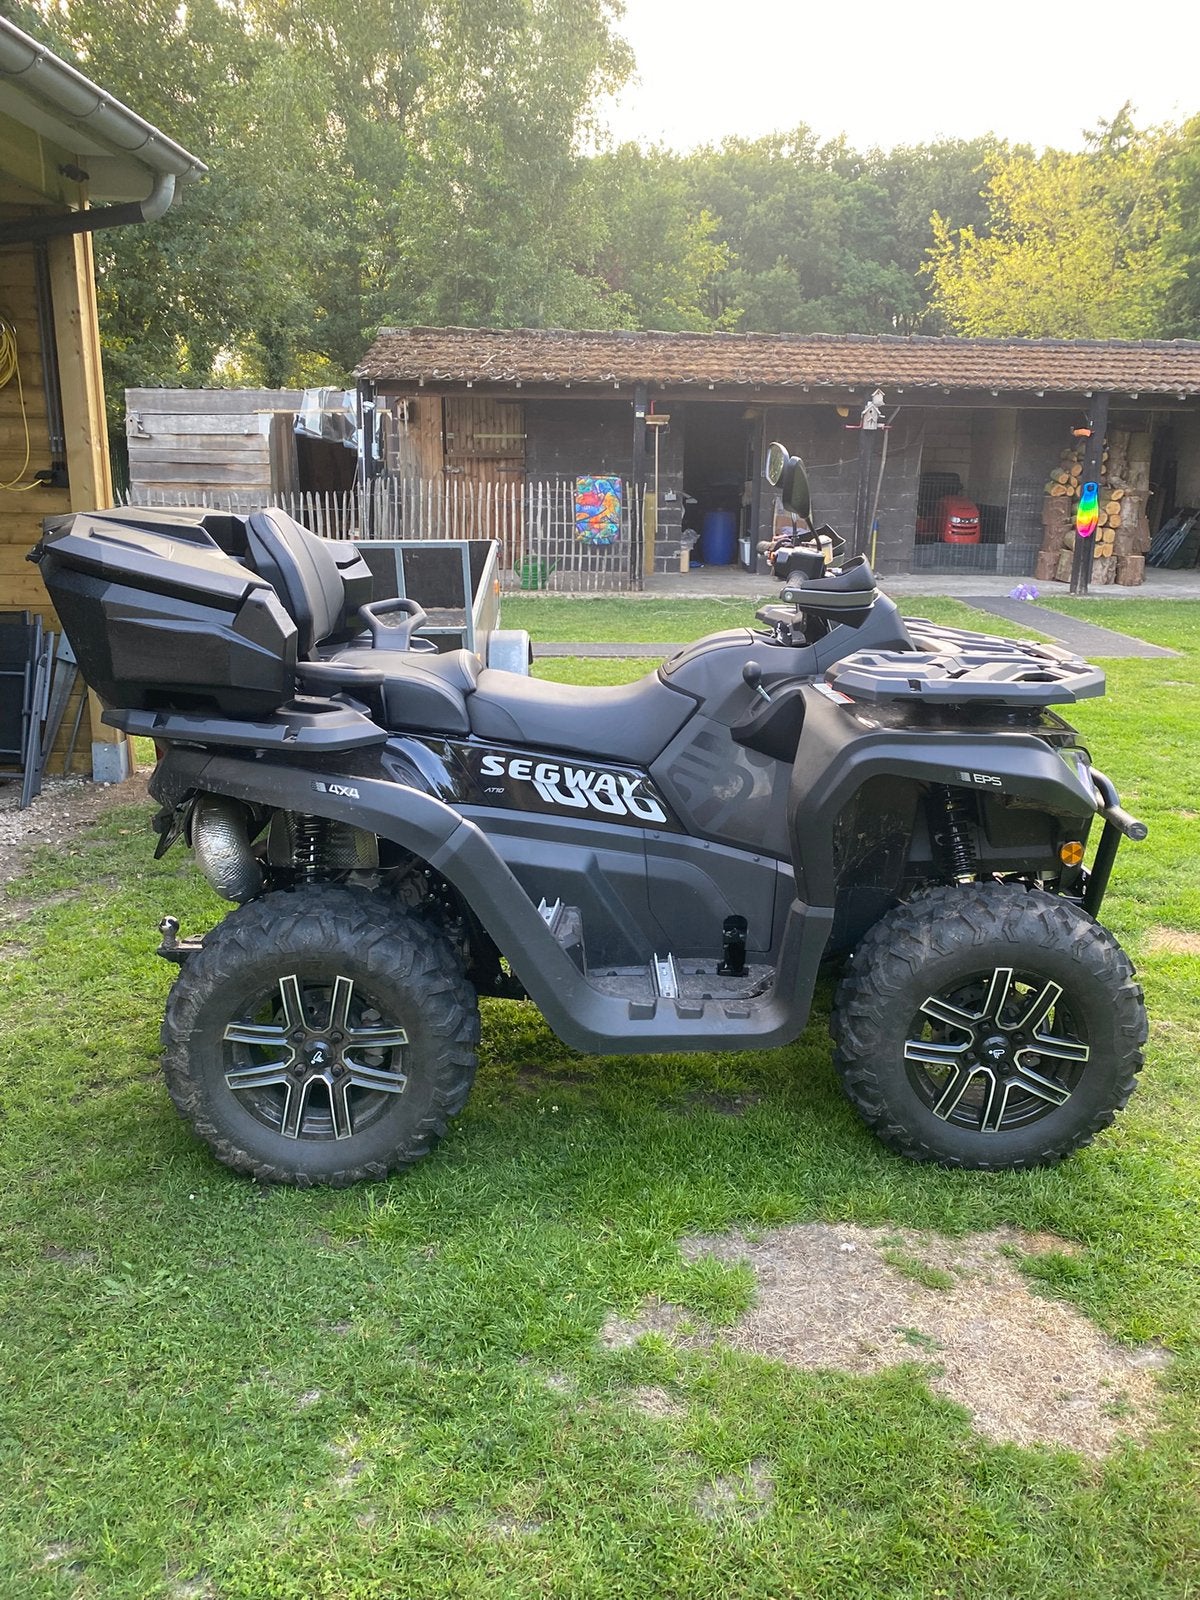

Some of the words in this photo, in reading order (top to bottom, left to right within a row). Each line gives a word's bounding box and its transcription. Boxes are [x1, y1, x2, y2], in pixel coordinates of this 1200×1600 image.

[480, 755, 642, 797] SEGWAY
[973, 773, 1002, 786] EPS
[328, 784, 360, 799] 4X4
